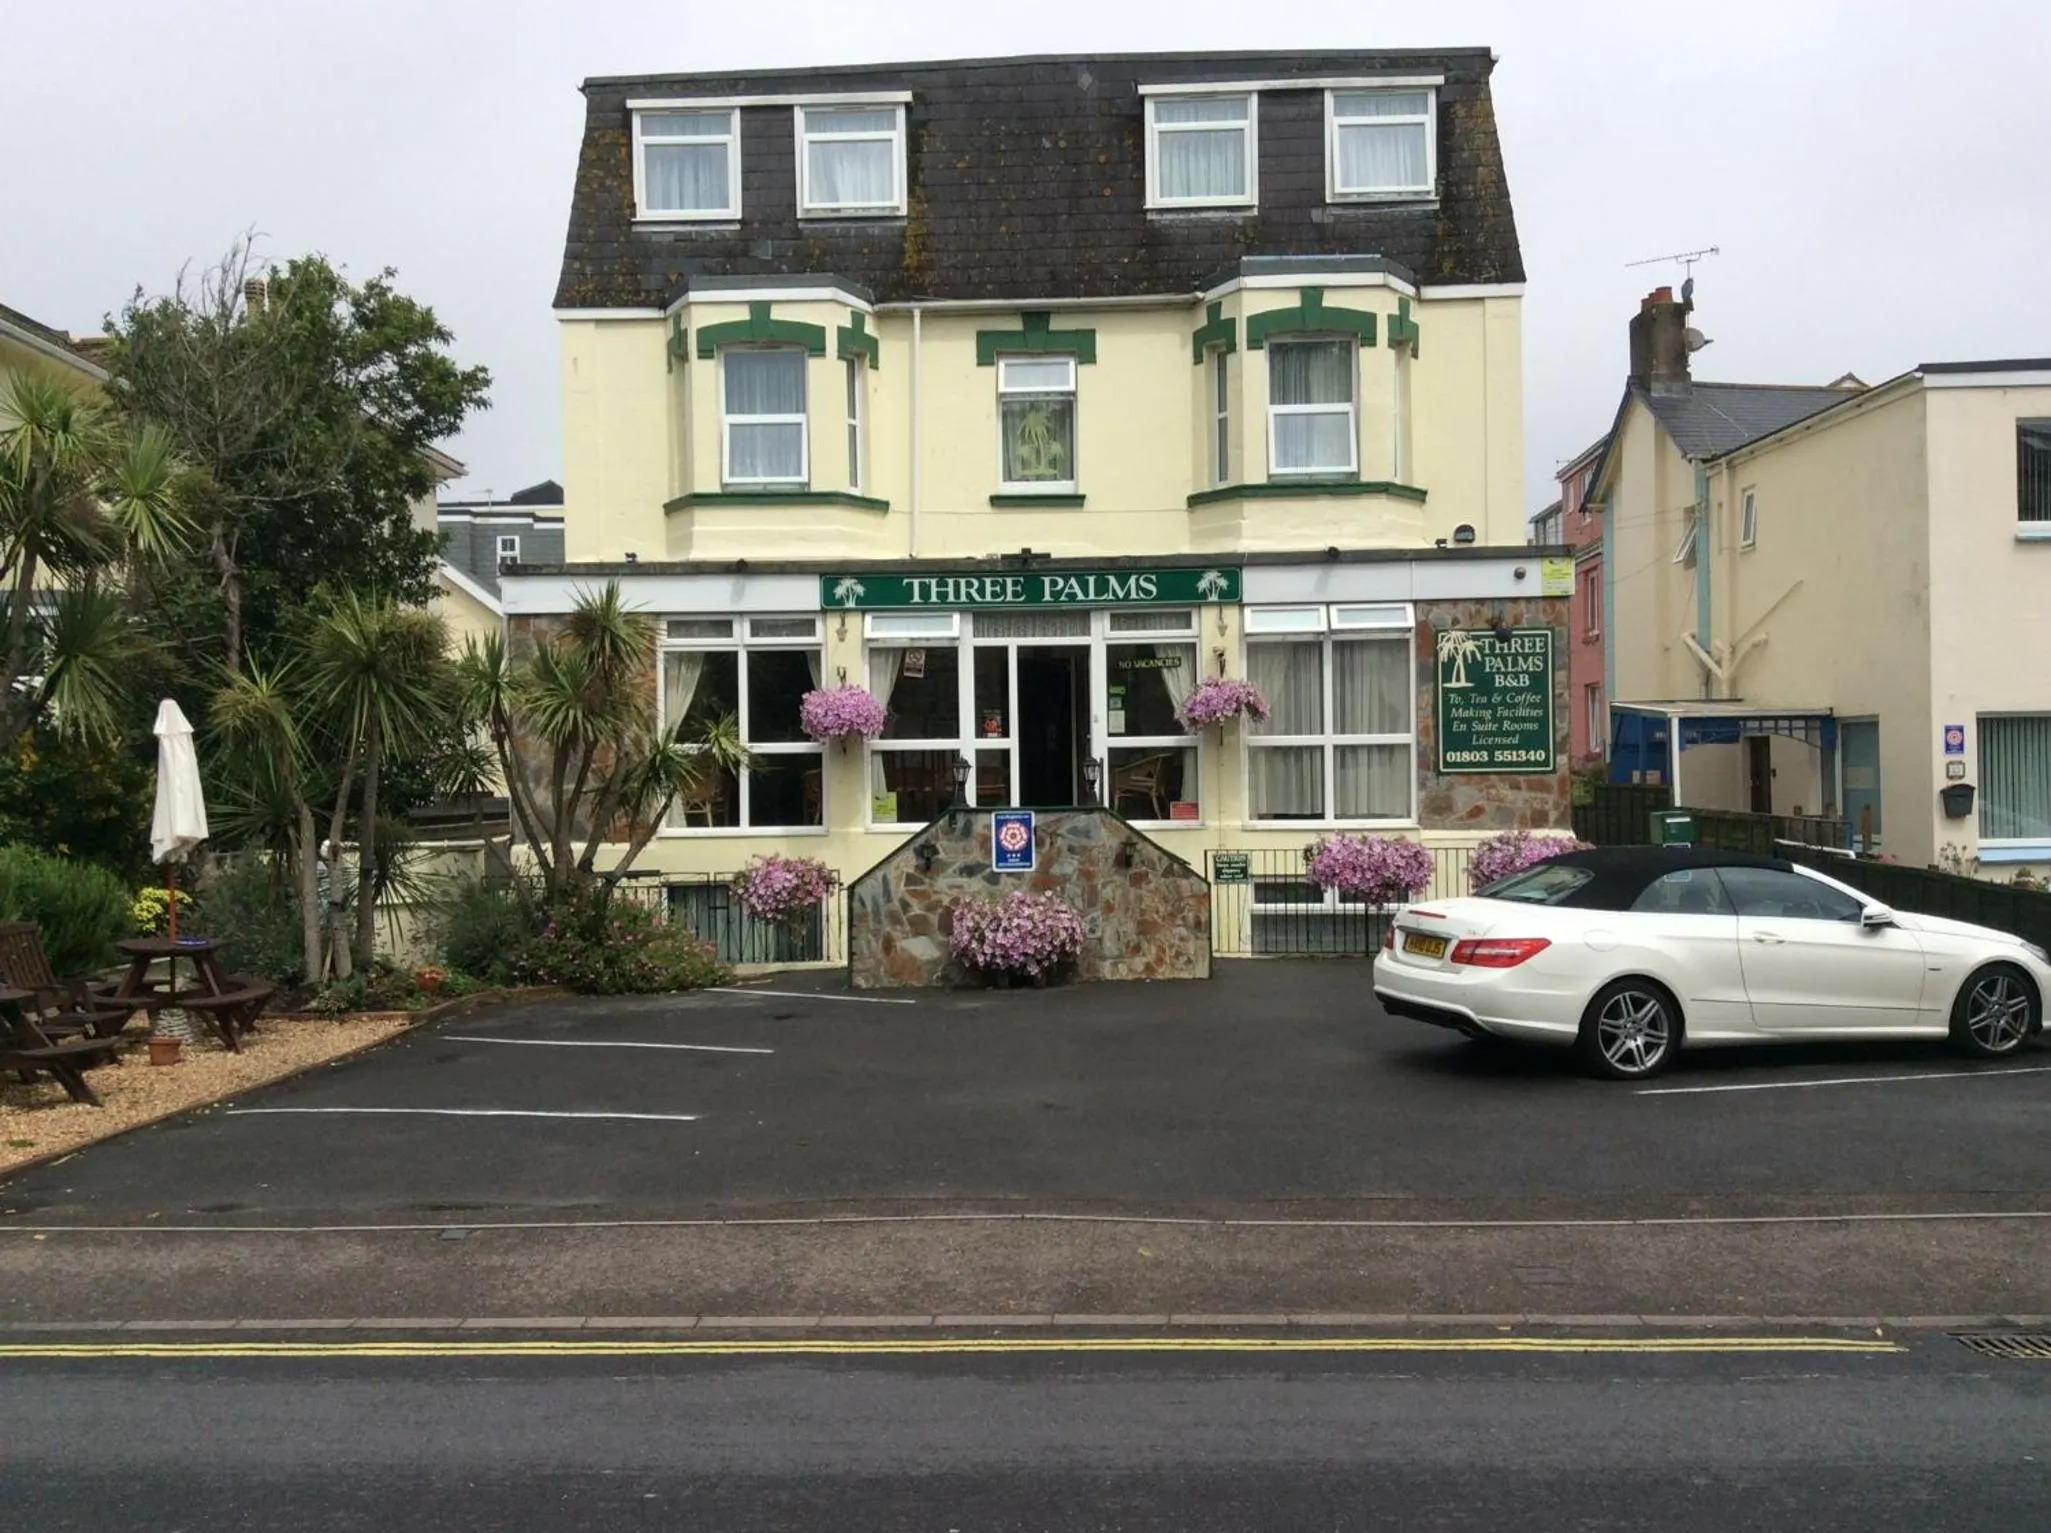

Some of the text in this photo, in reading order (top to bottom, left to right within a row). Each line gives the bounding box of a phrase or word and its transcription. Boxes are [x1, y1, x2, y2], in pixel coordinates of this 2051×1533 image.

[902, 574, 1157, 603] THREE PALMS
[1481, 637, 1546, 654] THREE
[1484, 656, 1543, 672] PALMS
[1495, 674, 1530, 687] B&B
[1470, 693, 1487, 704] Tea
[1491, 693, 1503, 703] &
[1506, 692, 1542, 707] Coffee
[1450, 706, 1543, 720] Making Facilities
[1452, 720, 1539, 732] En Suite Rooms
[1472, 734, 1519, 745] Licensed
[1446, 750, 1545, 762] 01803 551340
